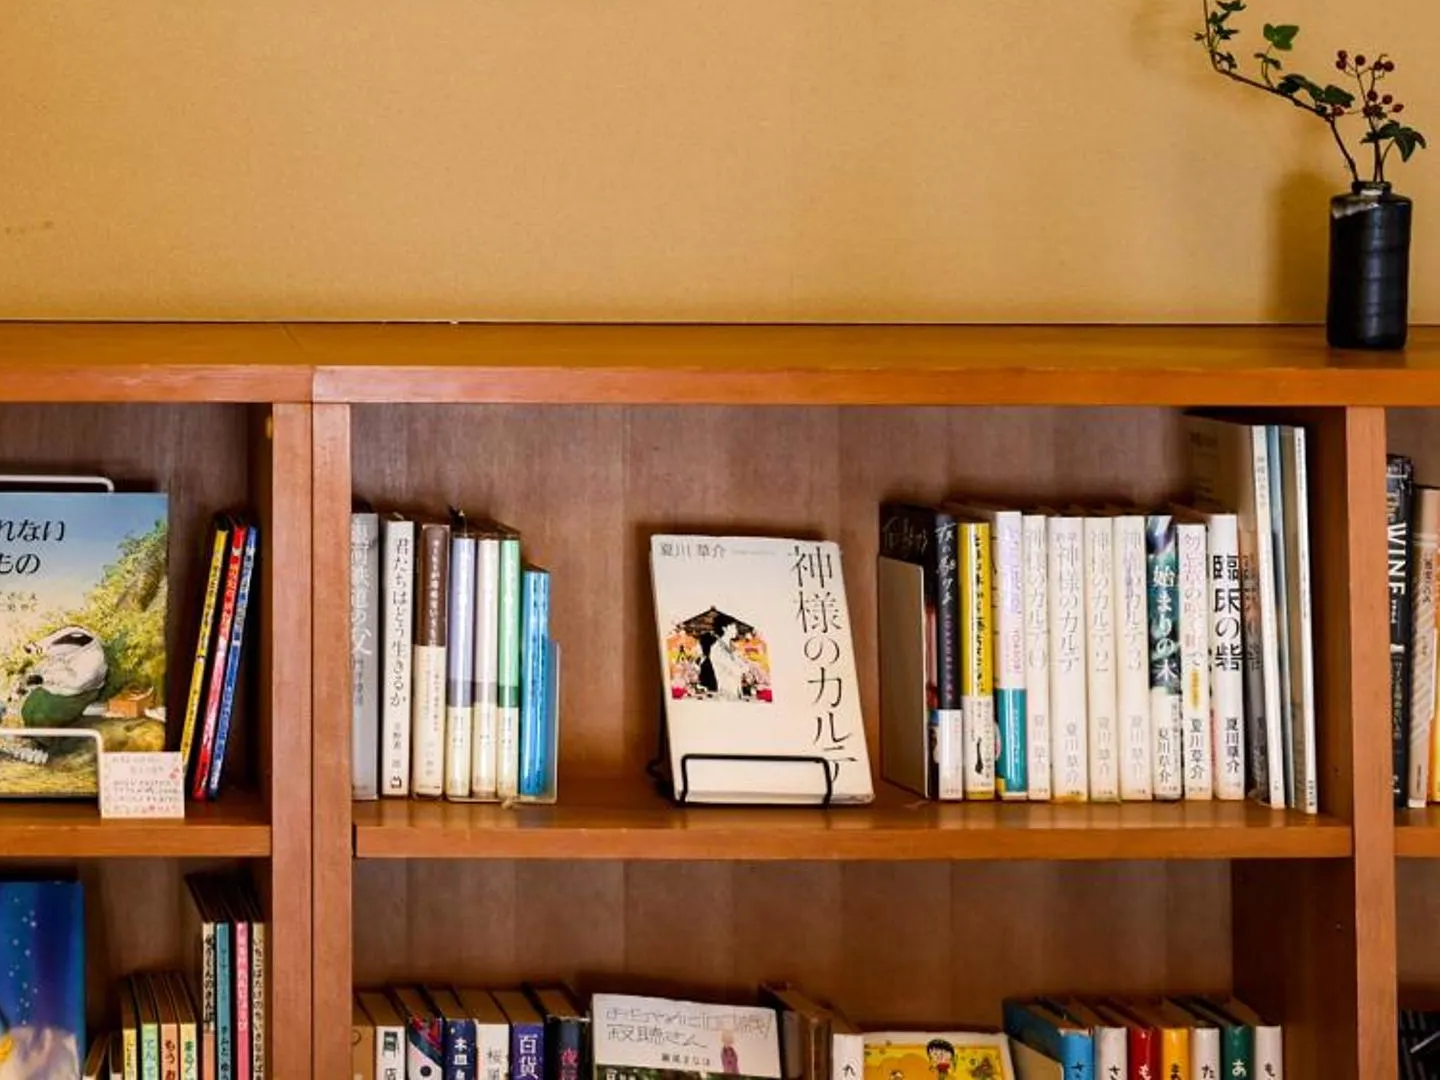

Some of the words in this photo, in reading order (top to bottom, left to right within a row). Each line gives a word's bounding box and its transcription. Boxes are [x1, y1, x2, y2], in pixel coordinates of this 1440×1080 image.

[391, 536, 409, 707] 君たちはどう生きるか
[792, 545, 857, 783] 神様のカルテ
[1152, 564, 1181, 685] 始まりの木
[1213, 554, 1242, 672] 臨床の砦
[1190, 719, 1205, 780] 夏川草介
[1225, 716, 1241, 773] 夏川草介
[518, 1034, 540, 1079] 百貨
